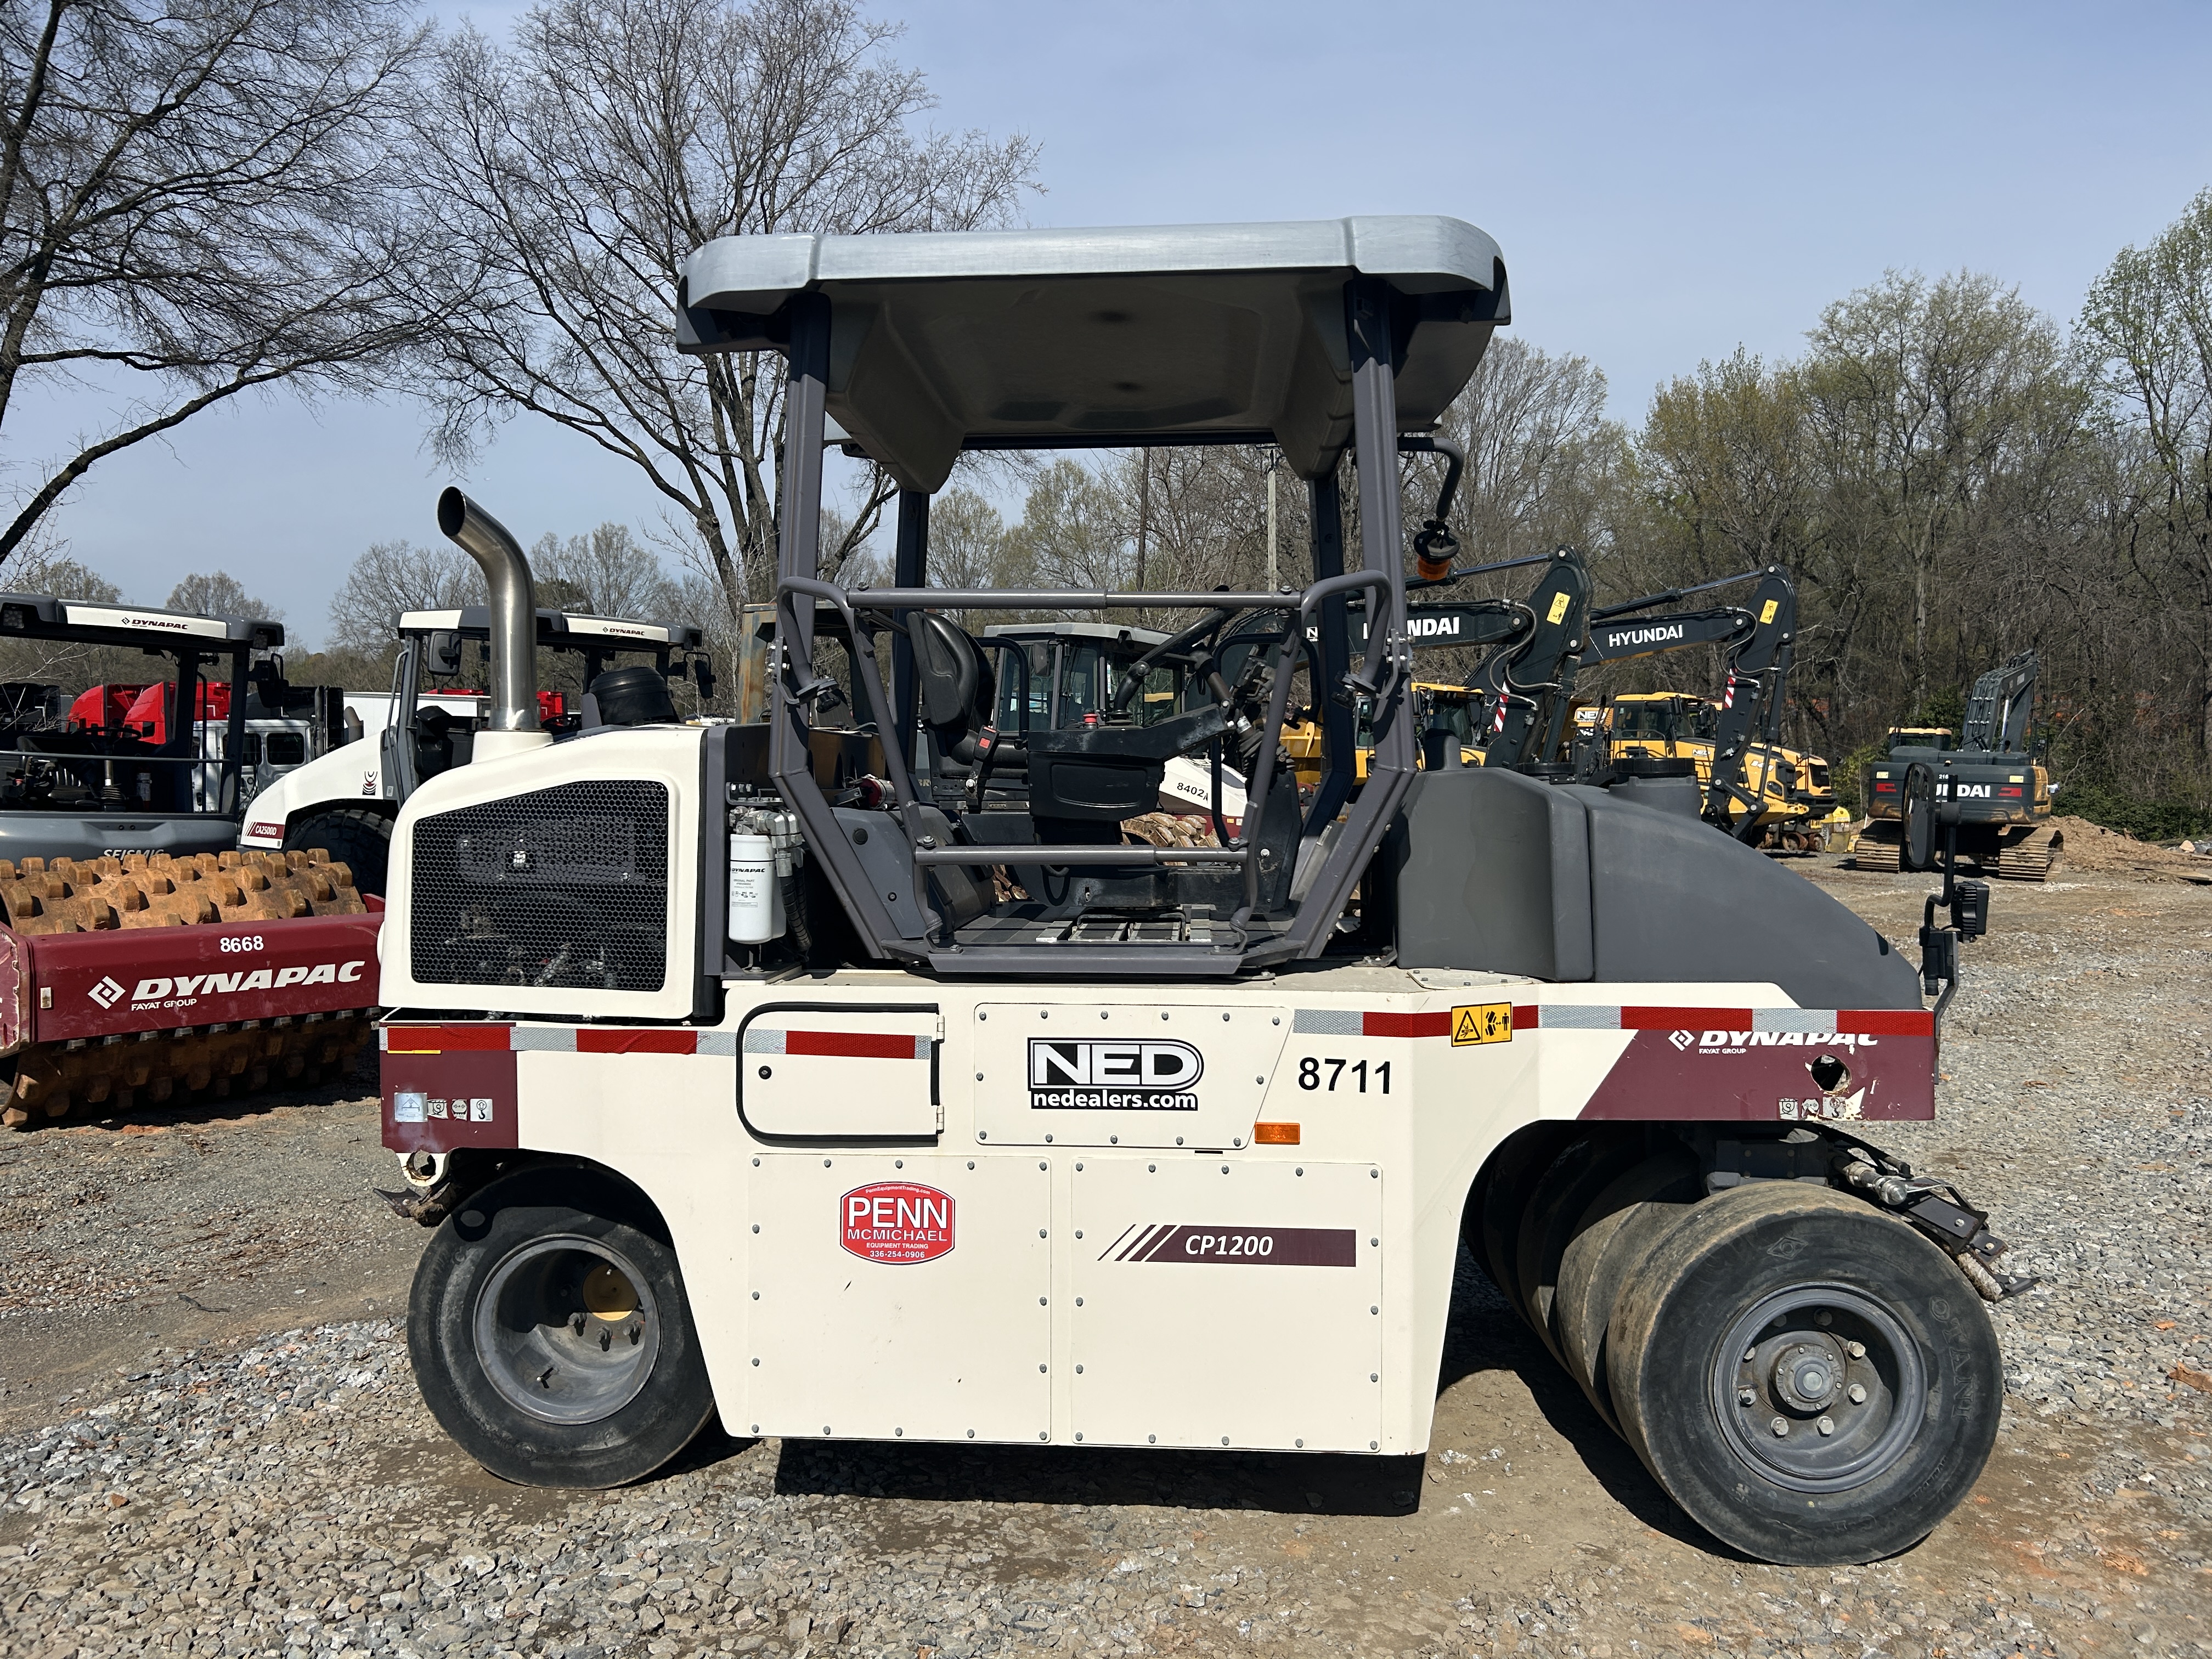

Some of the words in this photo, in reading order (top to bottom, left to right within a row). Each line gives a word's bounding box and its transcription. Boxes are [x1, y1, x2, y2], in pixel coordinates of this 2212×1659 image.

[132, 619, 188, 630] DYNAPAC
[609, 628, 645, 636] DYNAPAC
[1609, 624, 1683, 647] HYUNDAI
[255, 825, 277, 836] CA2500D
[220, 936, 263, 952] 8668
[132, 961, 365, 1001] DYNAPAC
[131, 1001, 161, 1011] FAYAT
[163, 998, 197, 1008] GROUP
[1699, 1030, 1878, 1047] DYNAPAC
[1034, 1044, 1198, 1085] NED
[1298, 1057, 1390, 1094] 8711
[1034, 1088, 1196, 1109] nedealers.com
[865, 1185, 931, 1195] PennEquipmentTrading.com
[849, 1197, 947, 1229] PENN
[847, 1229, 947, 1242] MCMICHAEL
[1185, 1234, 1273, 1256] CP1200
[1929, 1295, 1974, 1422] OTANI
